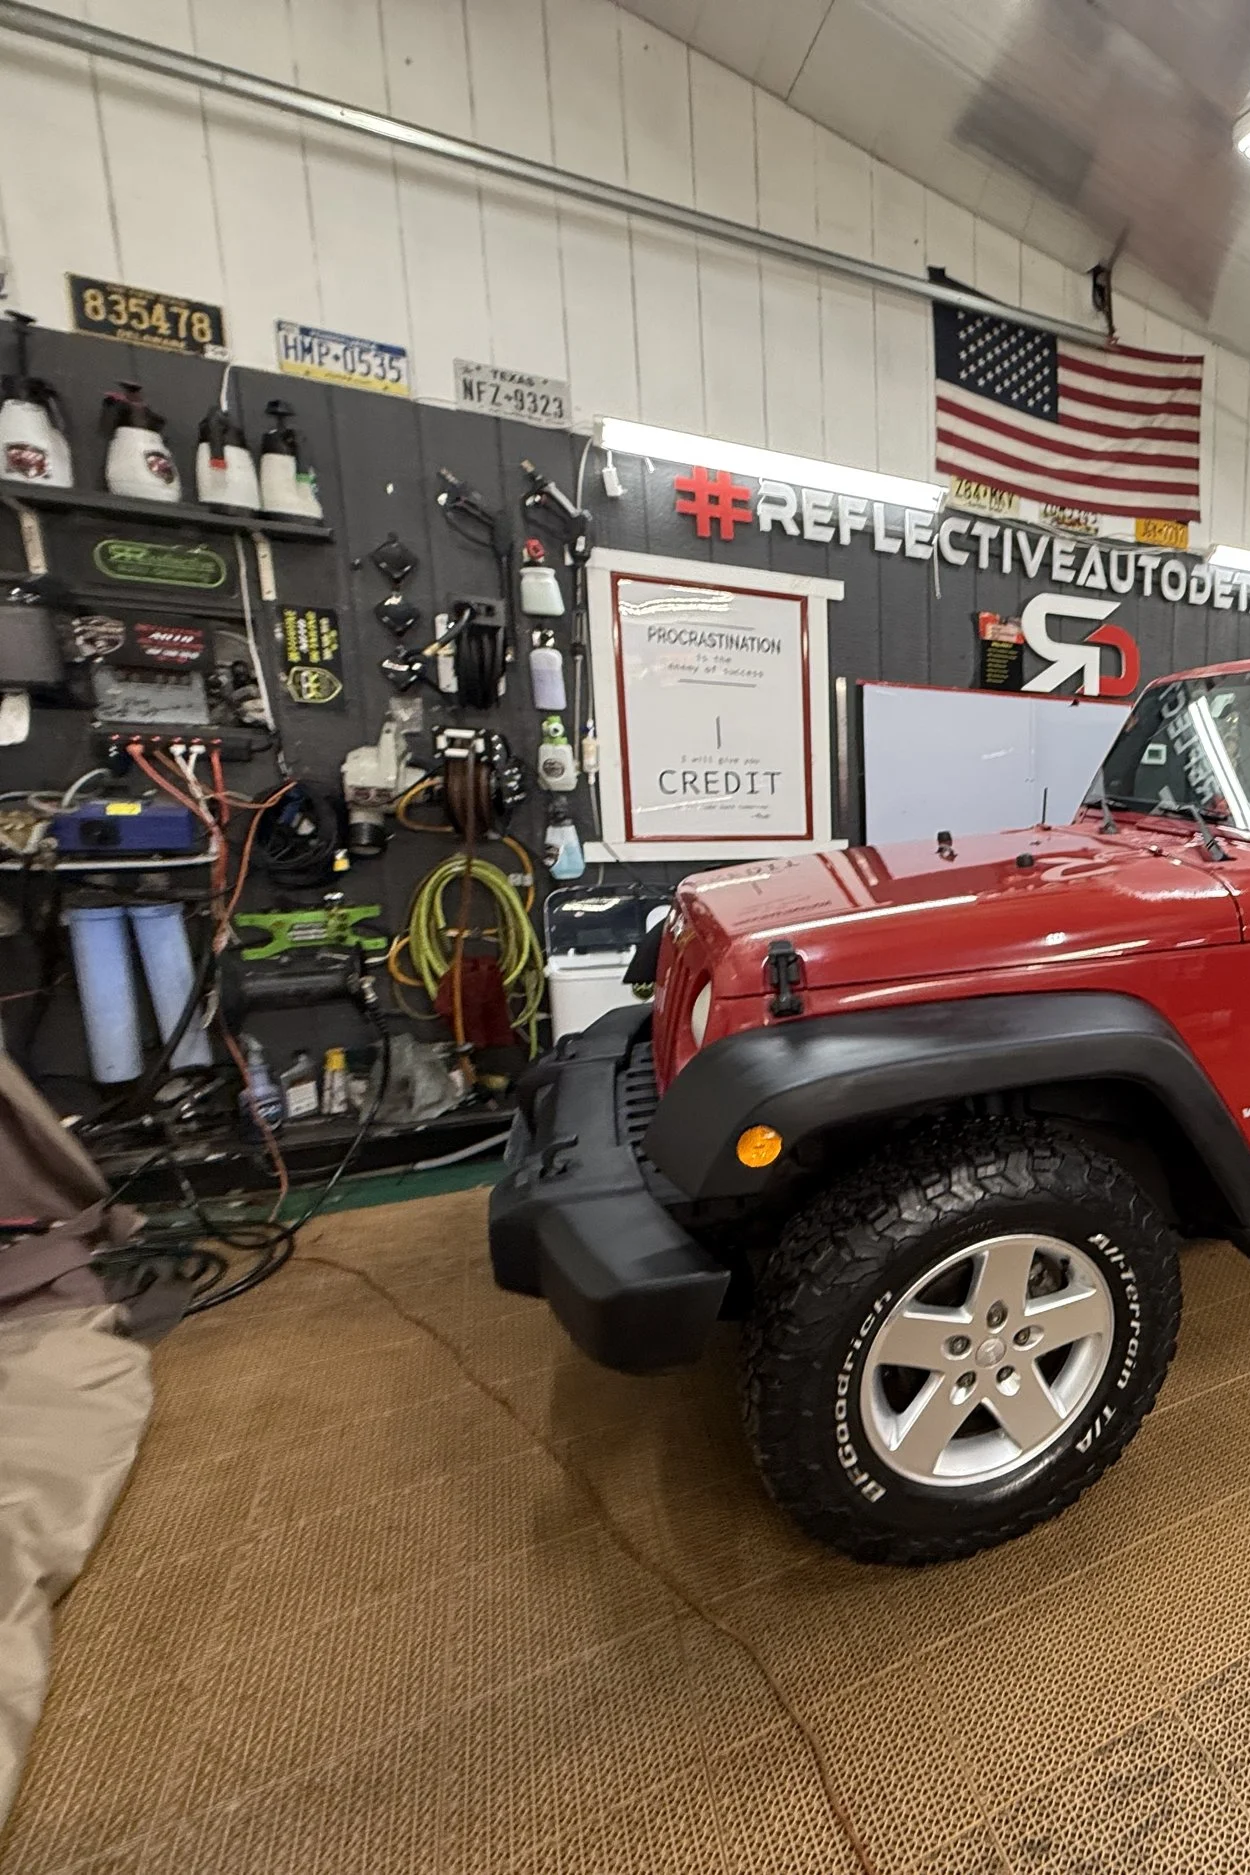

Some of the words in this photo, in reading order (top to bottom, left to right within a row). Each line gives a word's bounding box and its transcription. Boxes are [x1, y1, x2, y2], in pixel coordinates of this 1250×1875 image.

[83, 288, 213, 342] 835478
[491, 369, 535, 386] TEXAS
[648, 626, 781, 654] PROCRASTINATION
[667, 662, 698, 673] enemy
[705, 664, 717, 674] of
[723, 667, 764, 678] success
[714, 655, 731, 663] the
[692, 755, 713, 763] will
[659, 769, 782, 795] CREDIT
[1087, 1233, 1142, 1390] All-Terrain
[834, 1290, 893, 1503] BFGoodrich
[1075, 1404, 1117, 1454] T/A
